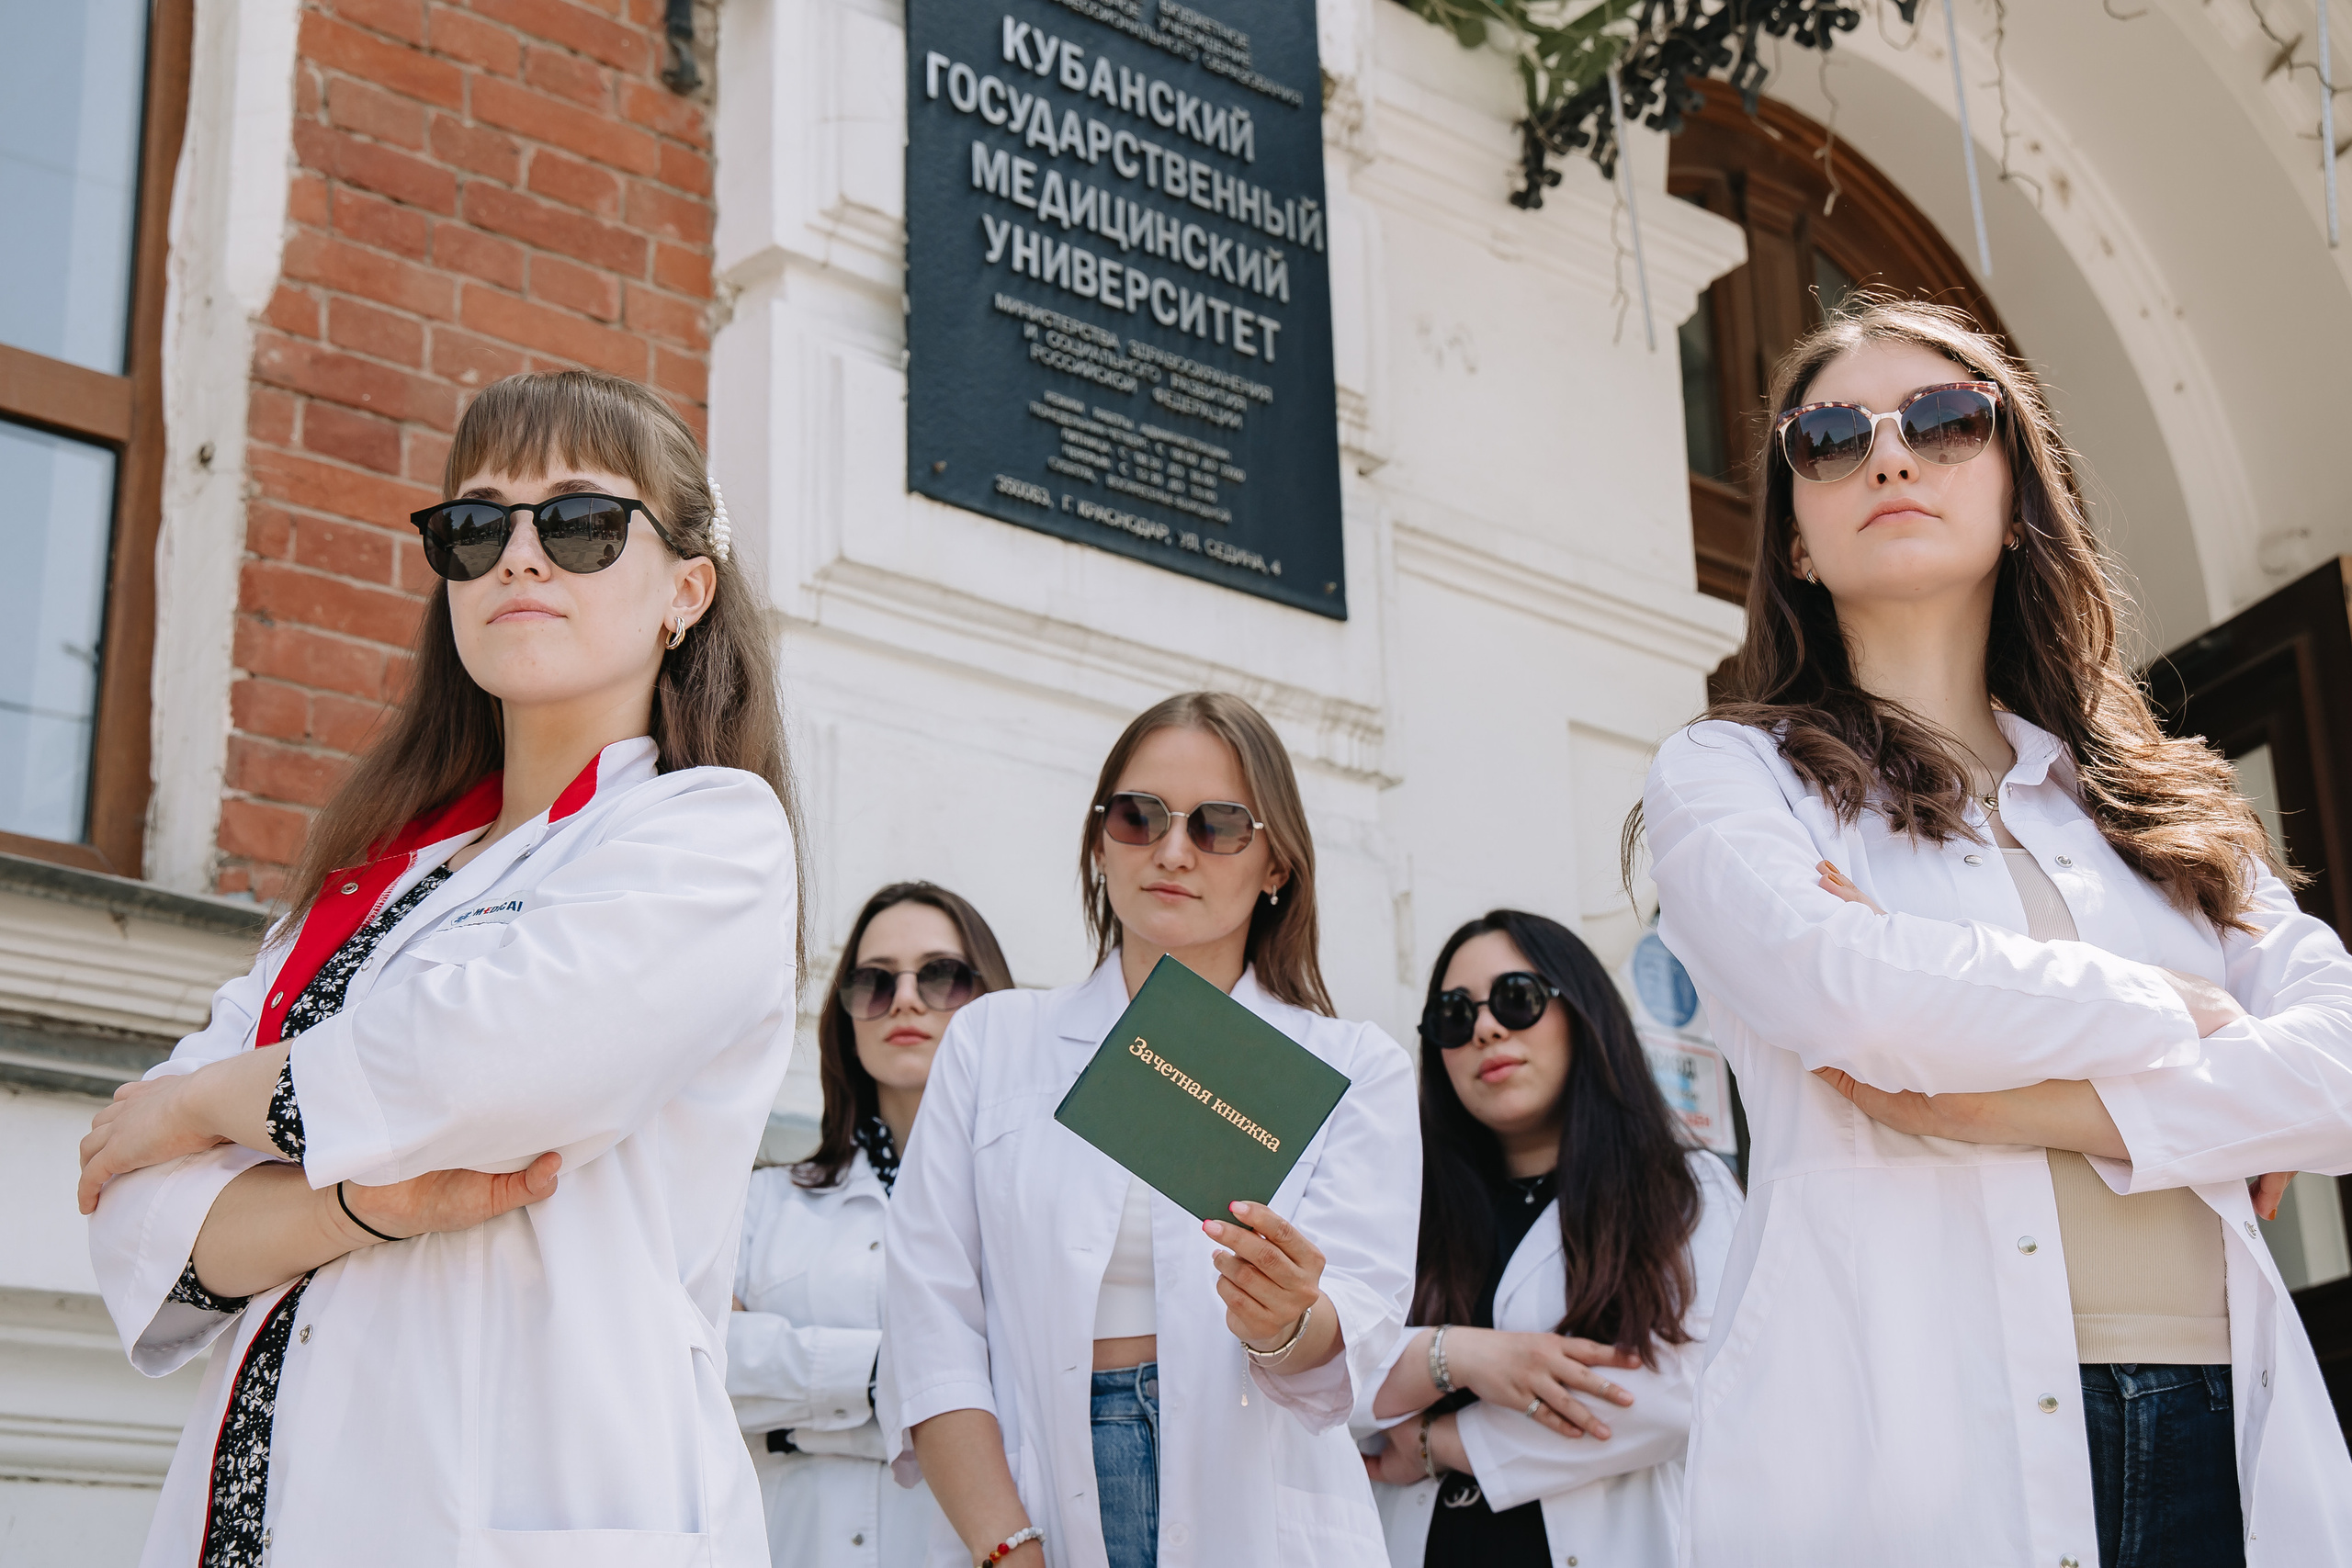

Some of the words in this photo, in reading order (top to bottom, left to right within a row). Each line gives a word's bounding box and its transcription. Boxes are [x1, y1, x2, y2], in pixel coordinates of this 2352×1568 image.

[926, 50, 1324, 253] ГОСУДАРСТВЕННЫЙ
[1002, 14, 1255, 163] КУБАНСКИЙ
[971, 140, 1290, 304] МЕДИЦИНСКИЙ
[981, 212, 1282, 363] УНИВЕРСИТЕТ
[994, 291, 1122, 349] МИНИСТЕРСТВА
[1023, 321, 1039, 341] И
[1046, 329, 1162, 384] СОЦИАЛЬНОГО
[1030, 343, 1138, 395] РОССИЙСКОЙ
[1128, 1035, 1215, 1105] Зачетная
[1210, 1097, 1282, 1154] книжка
